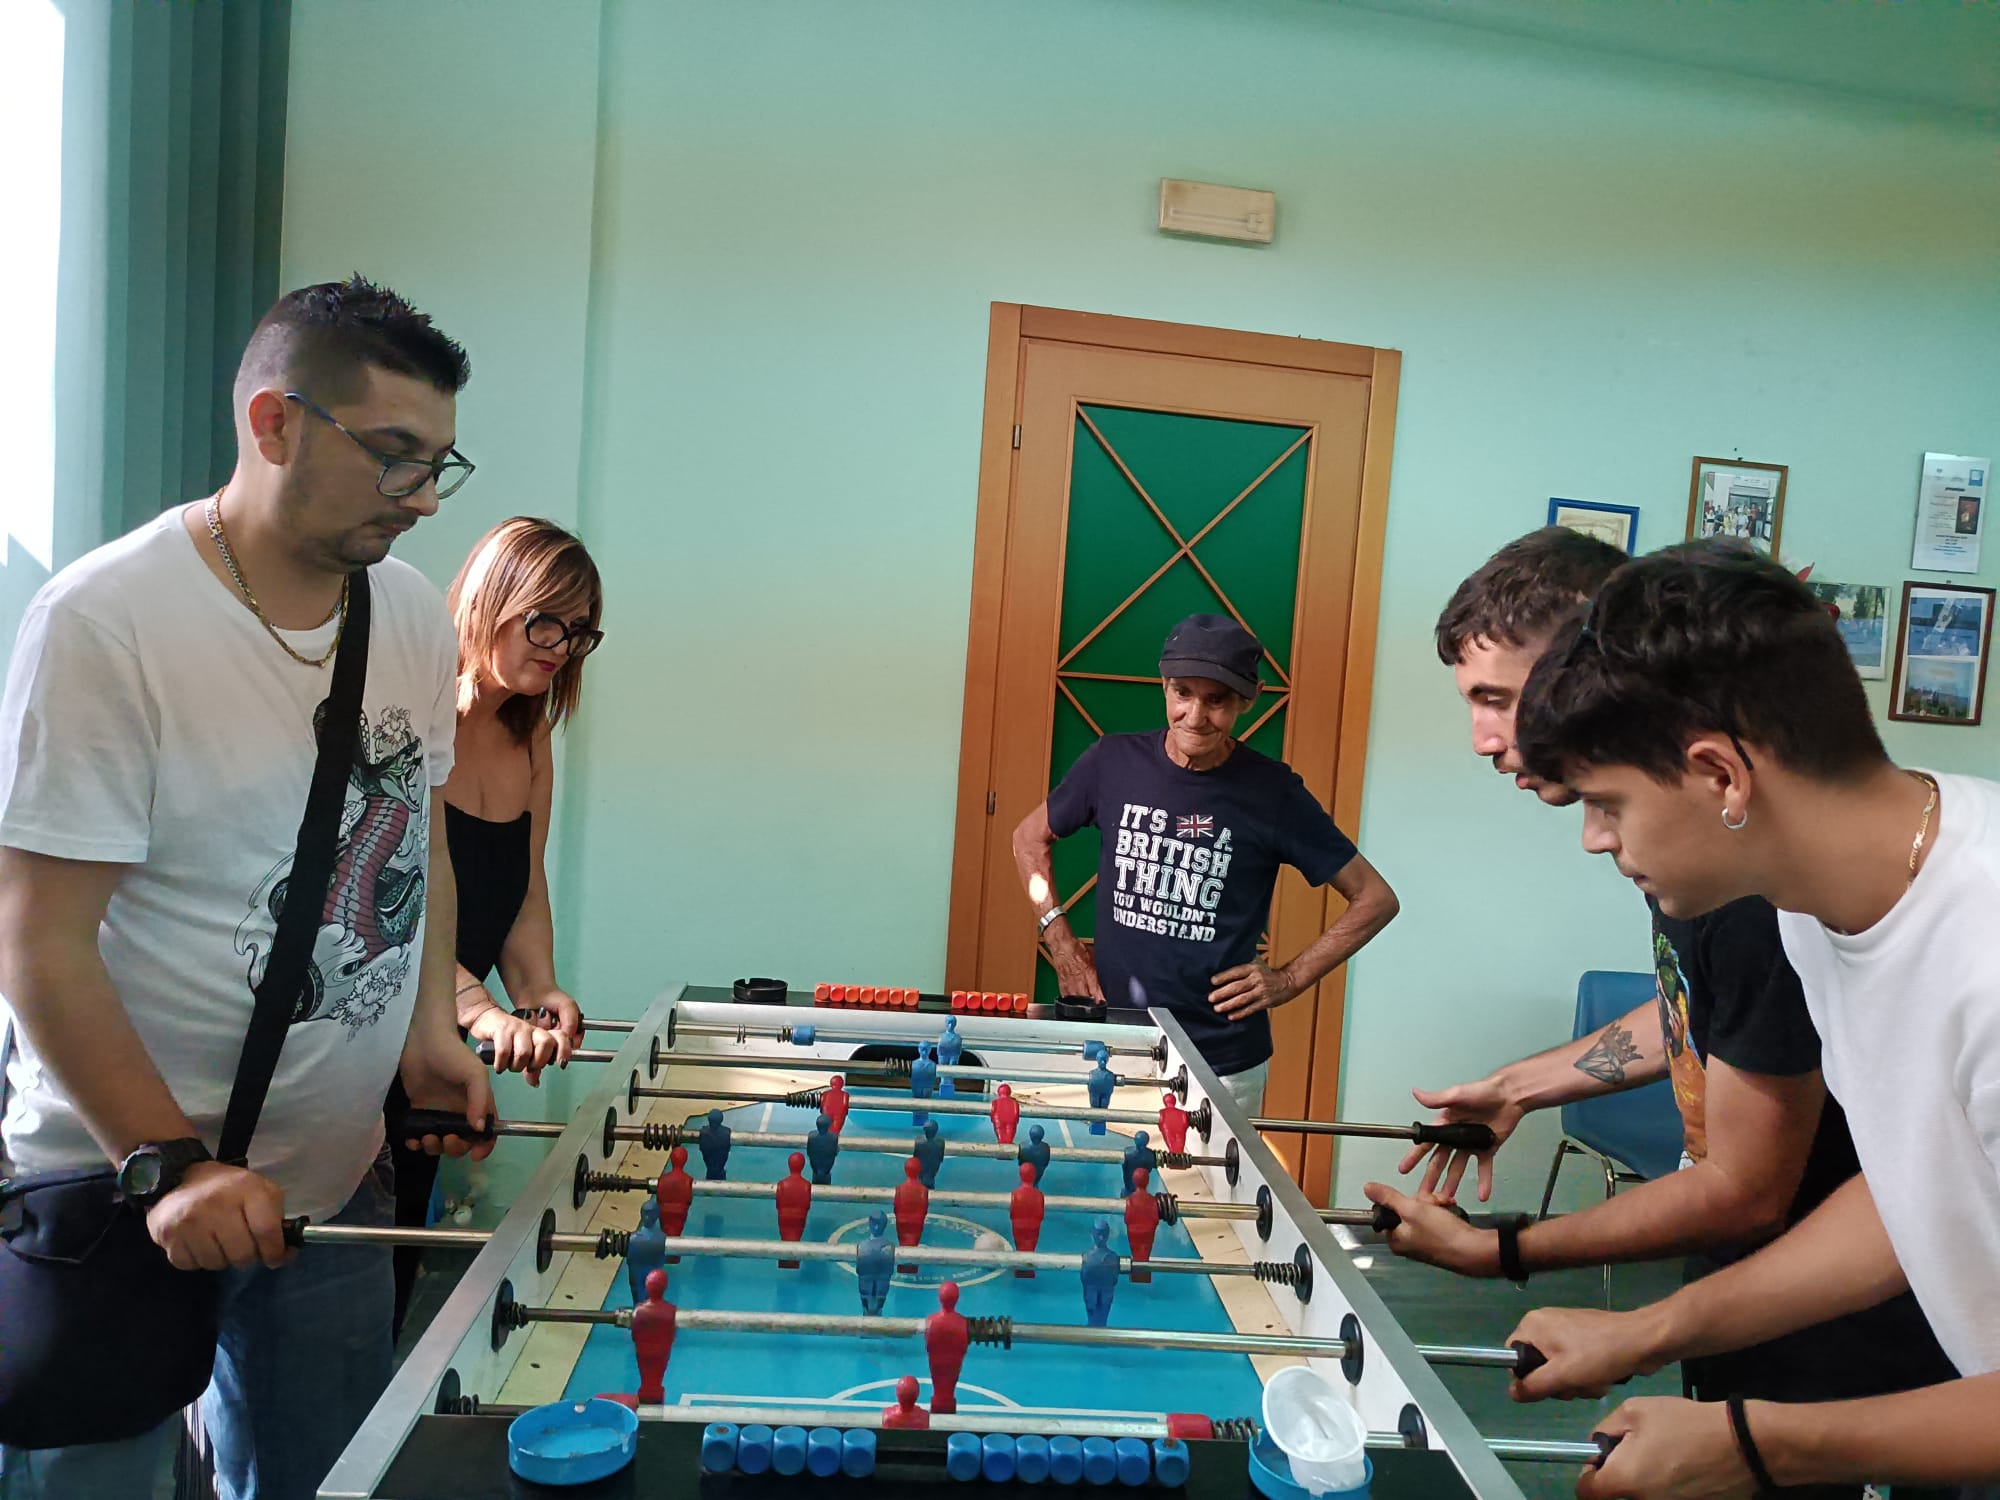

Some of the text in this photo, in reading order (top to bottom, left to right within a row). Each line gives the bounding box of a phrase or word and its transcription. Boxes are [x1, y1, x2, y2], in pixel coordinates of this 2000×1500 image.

[1120, 803, 1233, 851] IT'S A
[1115, 828, 1231, 878] BRITISH
[1114, 856, 1224, 909] THING
[1113, 890, 1216, 925] YOU WOULDN'T
[1113, 906, 1216, 942] UNDERSTAND
